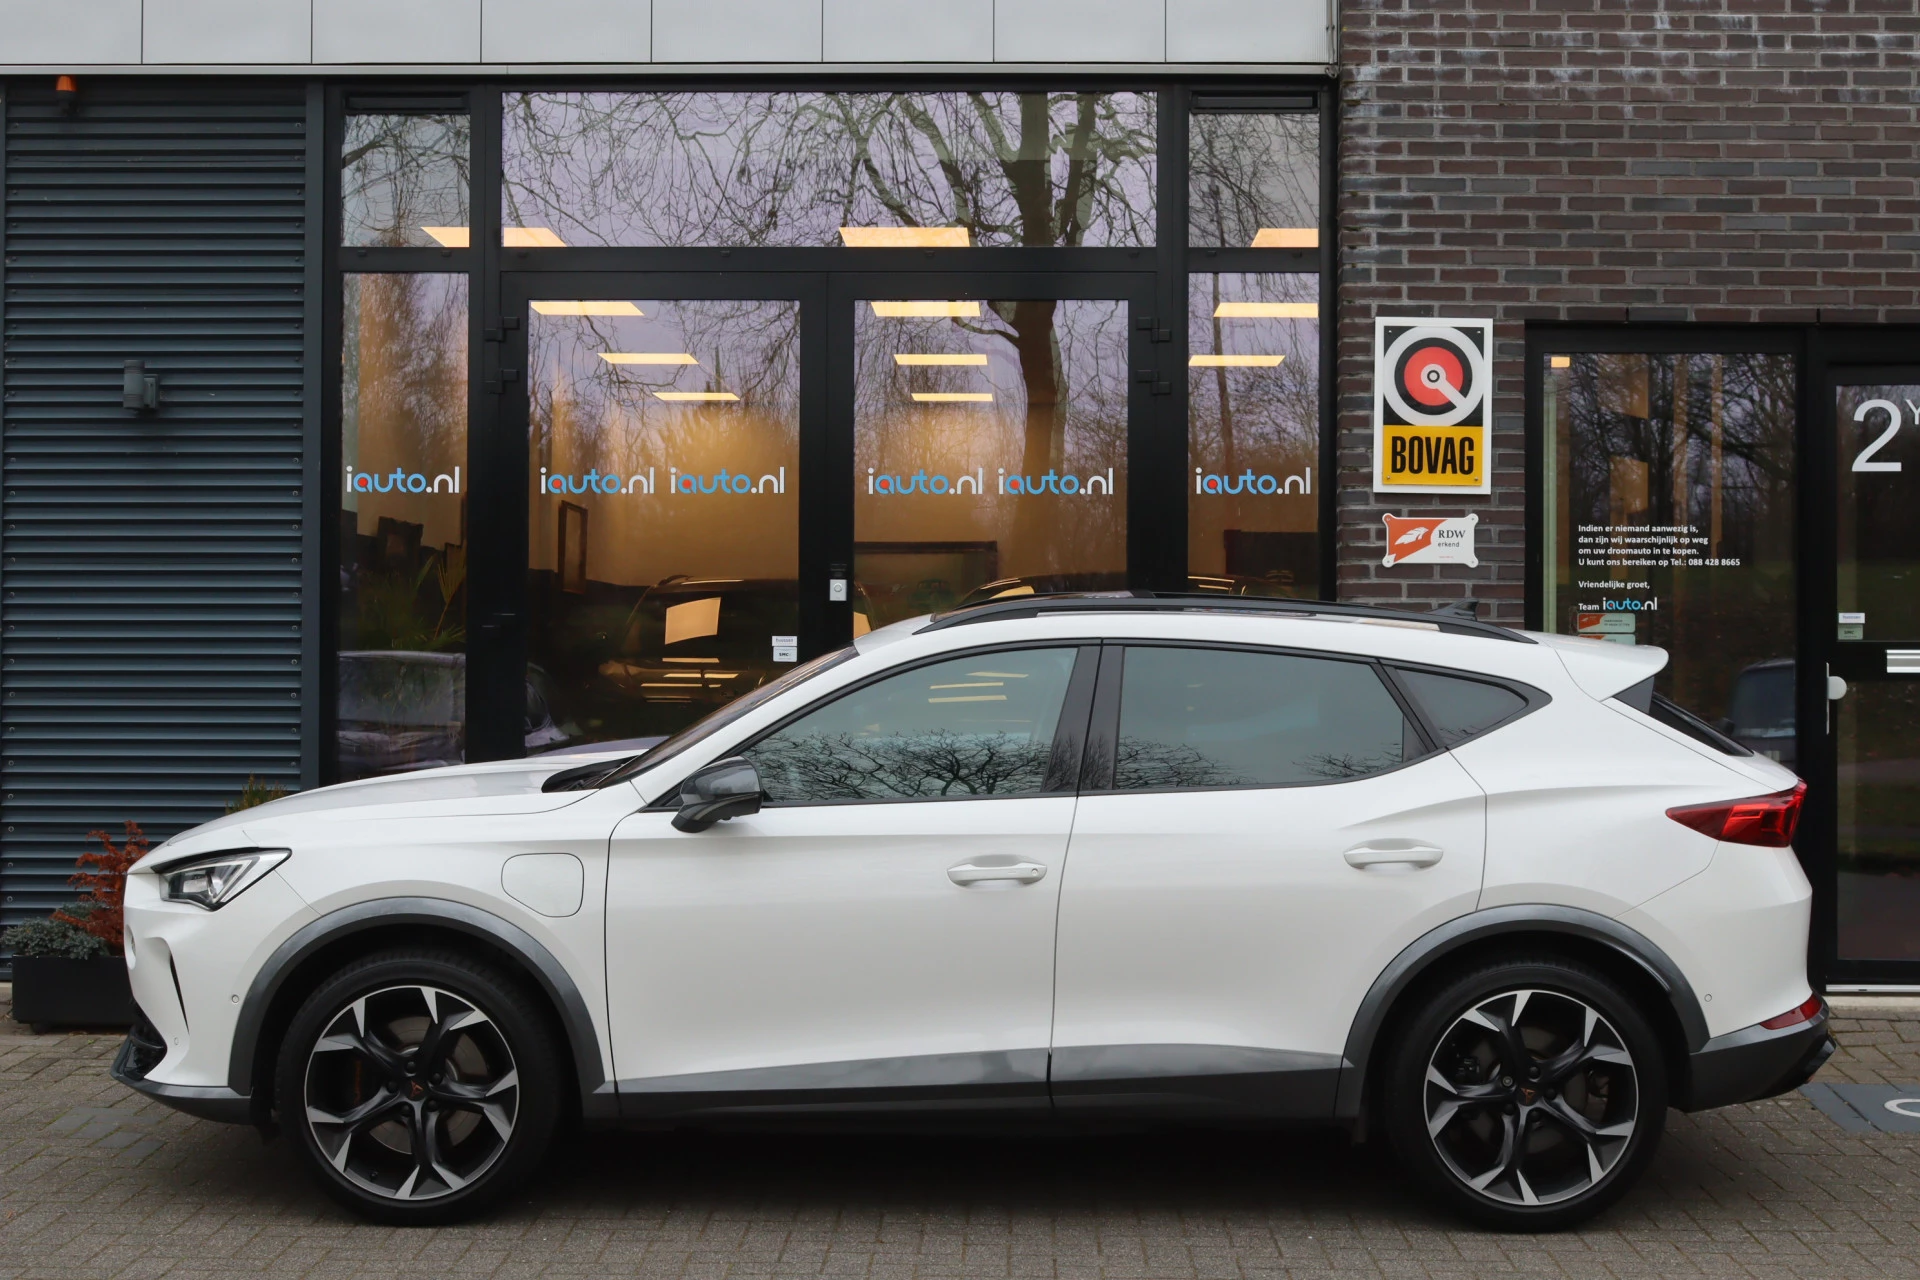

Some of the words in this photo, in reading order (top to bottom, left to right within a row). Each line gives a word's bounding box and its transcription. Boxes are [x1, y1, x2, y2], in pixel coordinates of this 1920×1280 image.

[1391, 435, 1474, 475] BOVAG
[346, 465, 460, 493] iauto.nl
[540, 467, 654, 494] iauto.nl
[670, 467, 785, 494] iauto.nl
[867, 467, 983, 495] iauto.nl
[997, 467, 1113, 495] iauto.nl
[1195, 467, 1311, 495] iauto.nl
[1438, 529, 1466, 538] RDW
[1651, 525, 1688, 533] aanwezig
[1689, 525, 1699, 533] is,
[1595, 536, 1609, 544] zijn
[1610, 536, 1622, 544] wij
[1624, 536, 1678, 545] waarschijnlijk
[1692, 537, 1709, 545] weg
[1672, 547, 1699, 556] kopen.
[1578, 580, 1625, 589] Vriendelijke
[1602, 596, 1658, 610] iauto.nl
